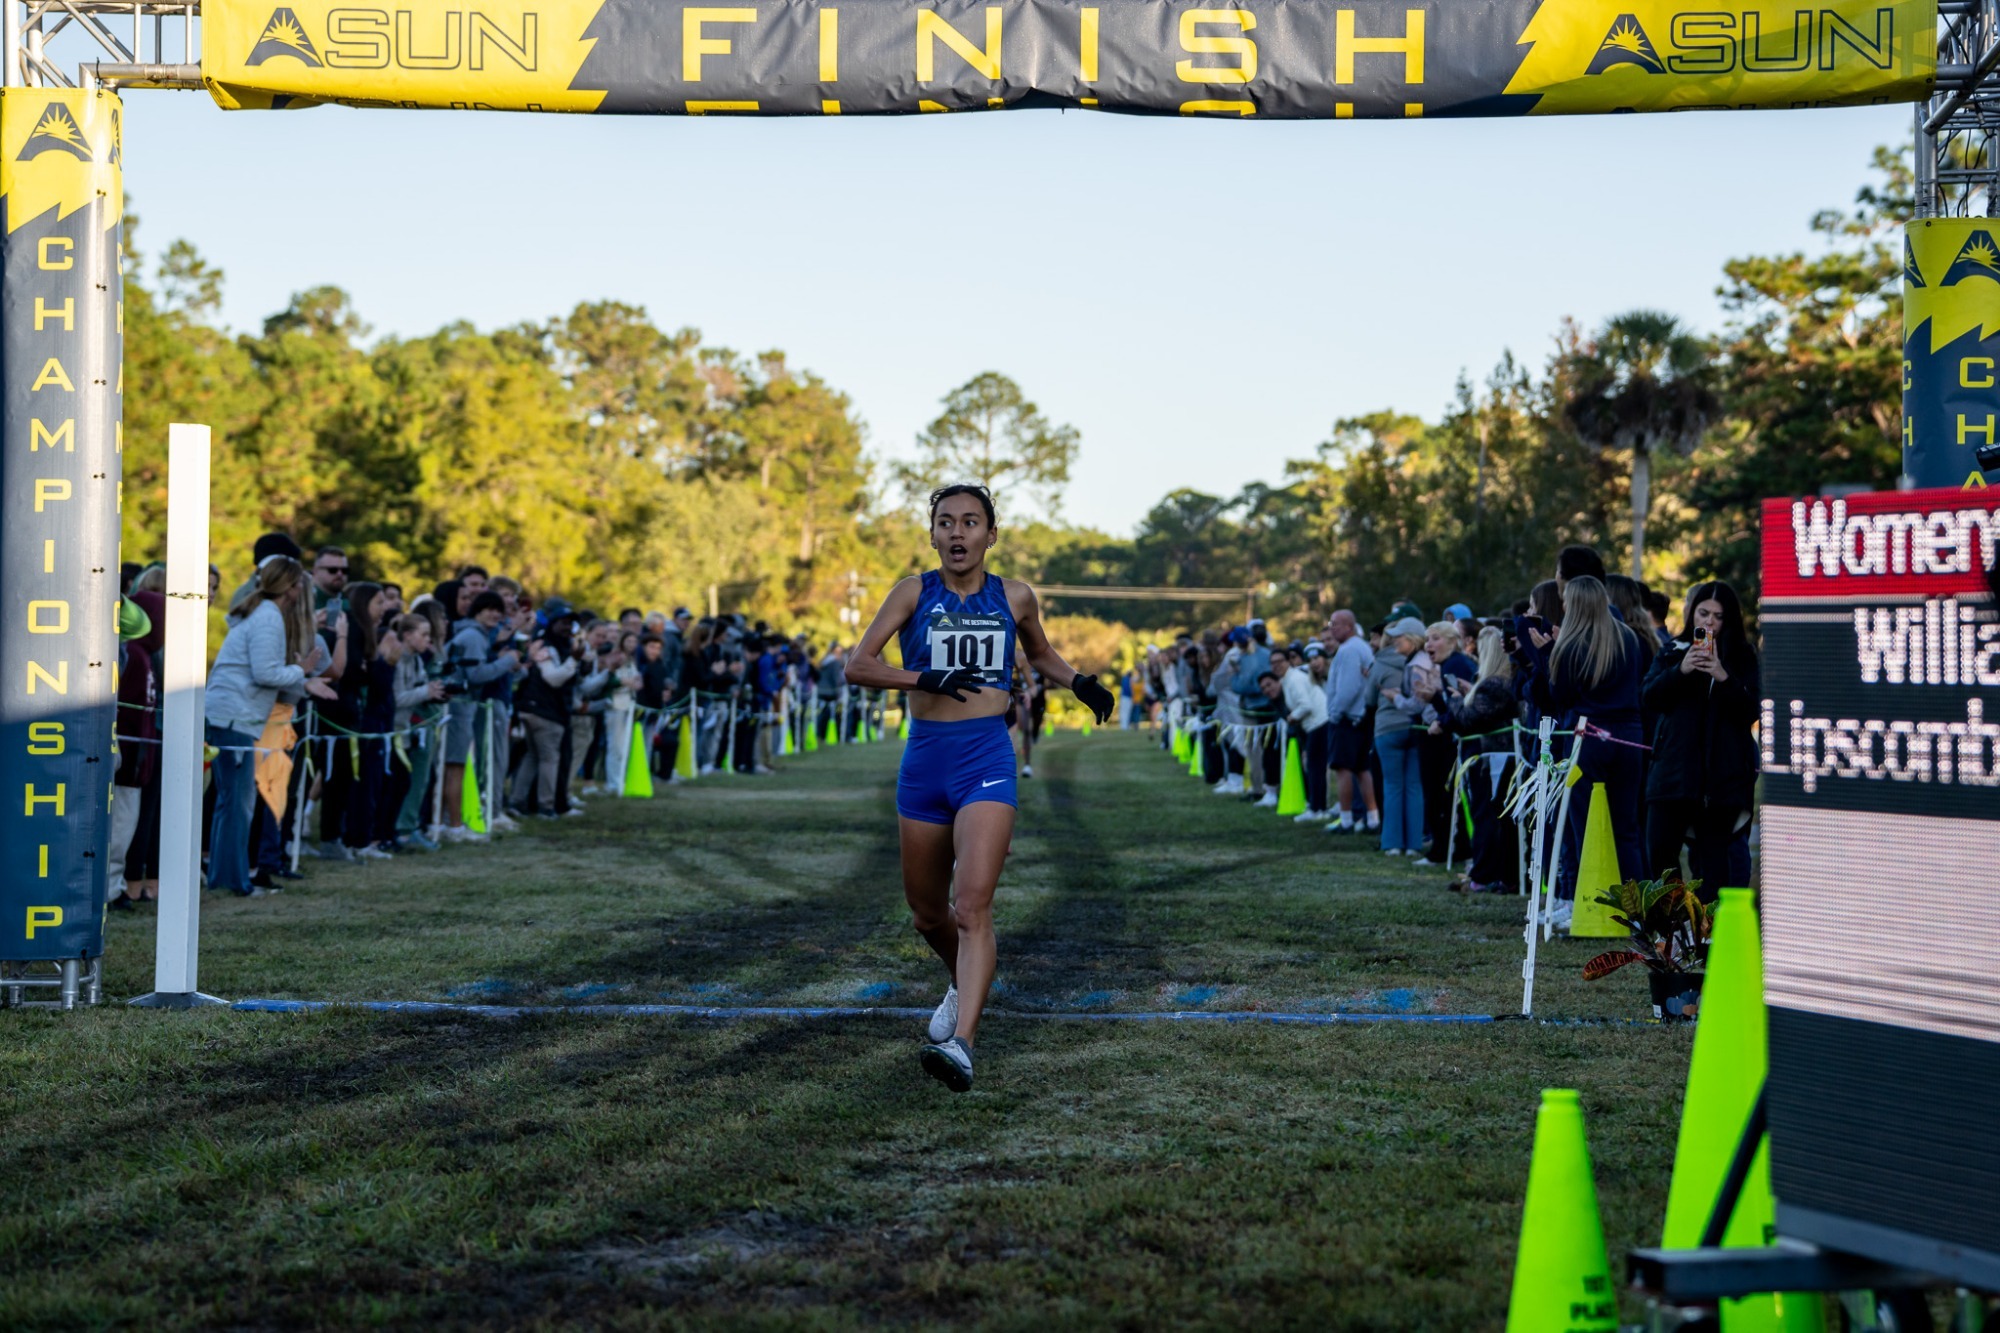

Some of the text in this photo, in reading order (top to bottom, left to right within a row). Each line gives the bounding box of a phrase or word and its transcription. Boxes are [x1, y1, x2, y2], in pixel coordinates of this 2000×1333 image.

[244, 7, 538, 71] ASUN
[682, 7, 1425, 84] FINISH
[1584, 7, 1893, 75] ASUN
[1792, 499, 2000, 577] Women
[24, 236, 75, 941] CHAMPIONSHIP
[941, 633, 994, 668] 101
